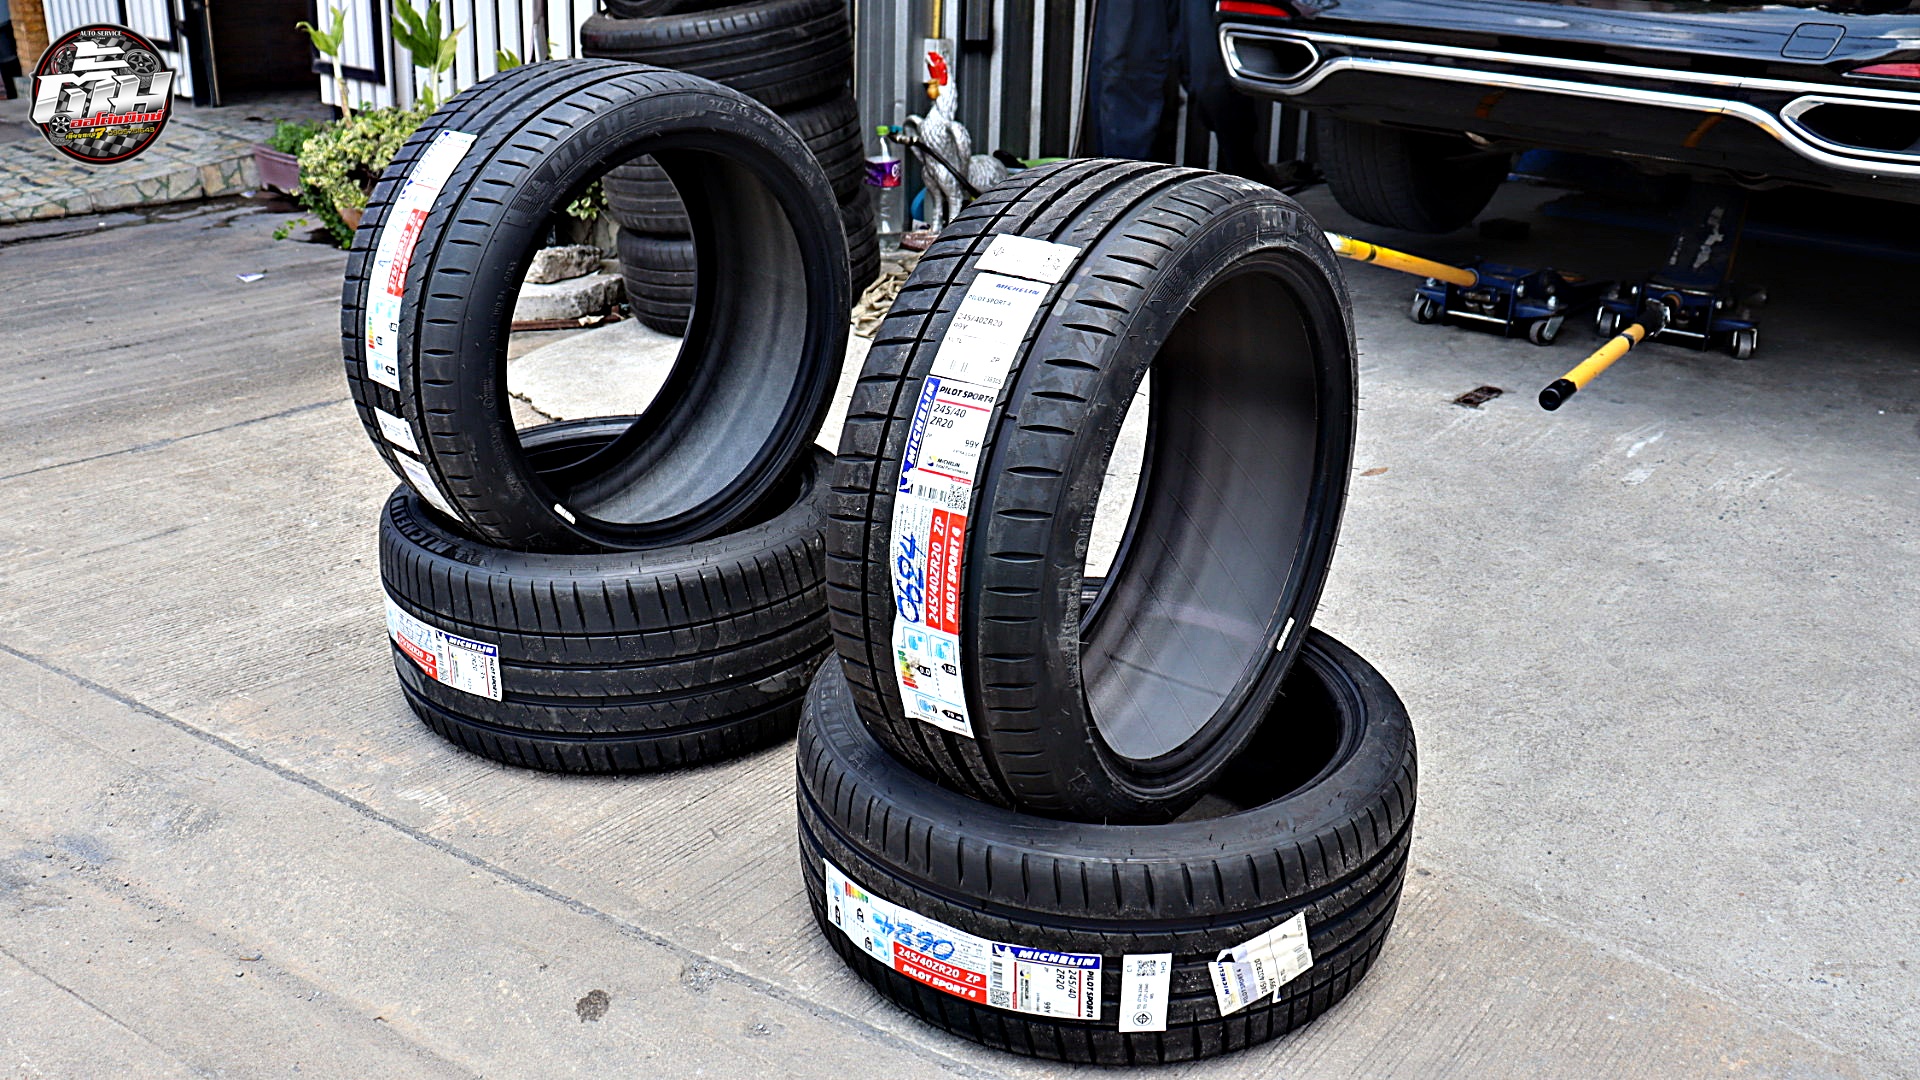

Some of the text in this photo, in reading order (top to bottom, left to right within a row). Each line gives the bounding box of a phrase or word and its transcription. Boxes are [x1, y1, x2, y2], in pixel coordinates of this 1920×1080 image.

[996, 283, 1040, 295] MICHELIN
[968, 294, 985, 303] PILOT
[986, 297, 1006, 306] SPORT
[957, 312, 1003, 328] 245/40ZR20
[939, 385, 962, 397] PILOT
[933, 403, 967, 418] 245/40
[906, 381, 938, 465] MICHELIN
[929, 416, 954, 429] ZR20
[965, 439, 980, 449] 99Y
[390, 496, 453, 554] MICHELIN
[928, 515, 945, 624] 245/40ZR20 ZP
[945, 526, 962, 624] PILOT SPORT 4
[448, 637, 494, 653] MICHELIN
[425, 653, 434, 662] ZP
[898, 947, 981, 984] 245/40ZR20 ZP
[1018, 950, 1096, 966] MICHELIN
[902, 965, 977, 998] PILOT SPORT 4
[1056, 968, 1065, 991] ZR20
[1068, 969, 1077, 999] 245/40
[1086, 970, 1094, 993] PILOT
[1217, 961, 1230, 995] MICHELIN
[1254, 958, 1268, 994] 245/40ZR20
[1043, 1001, 1051, 1014] 99Y
